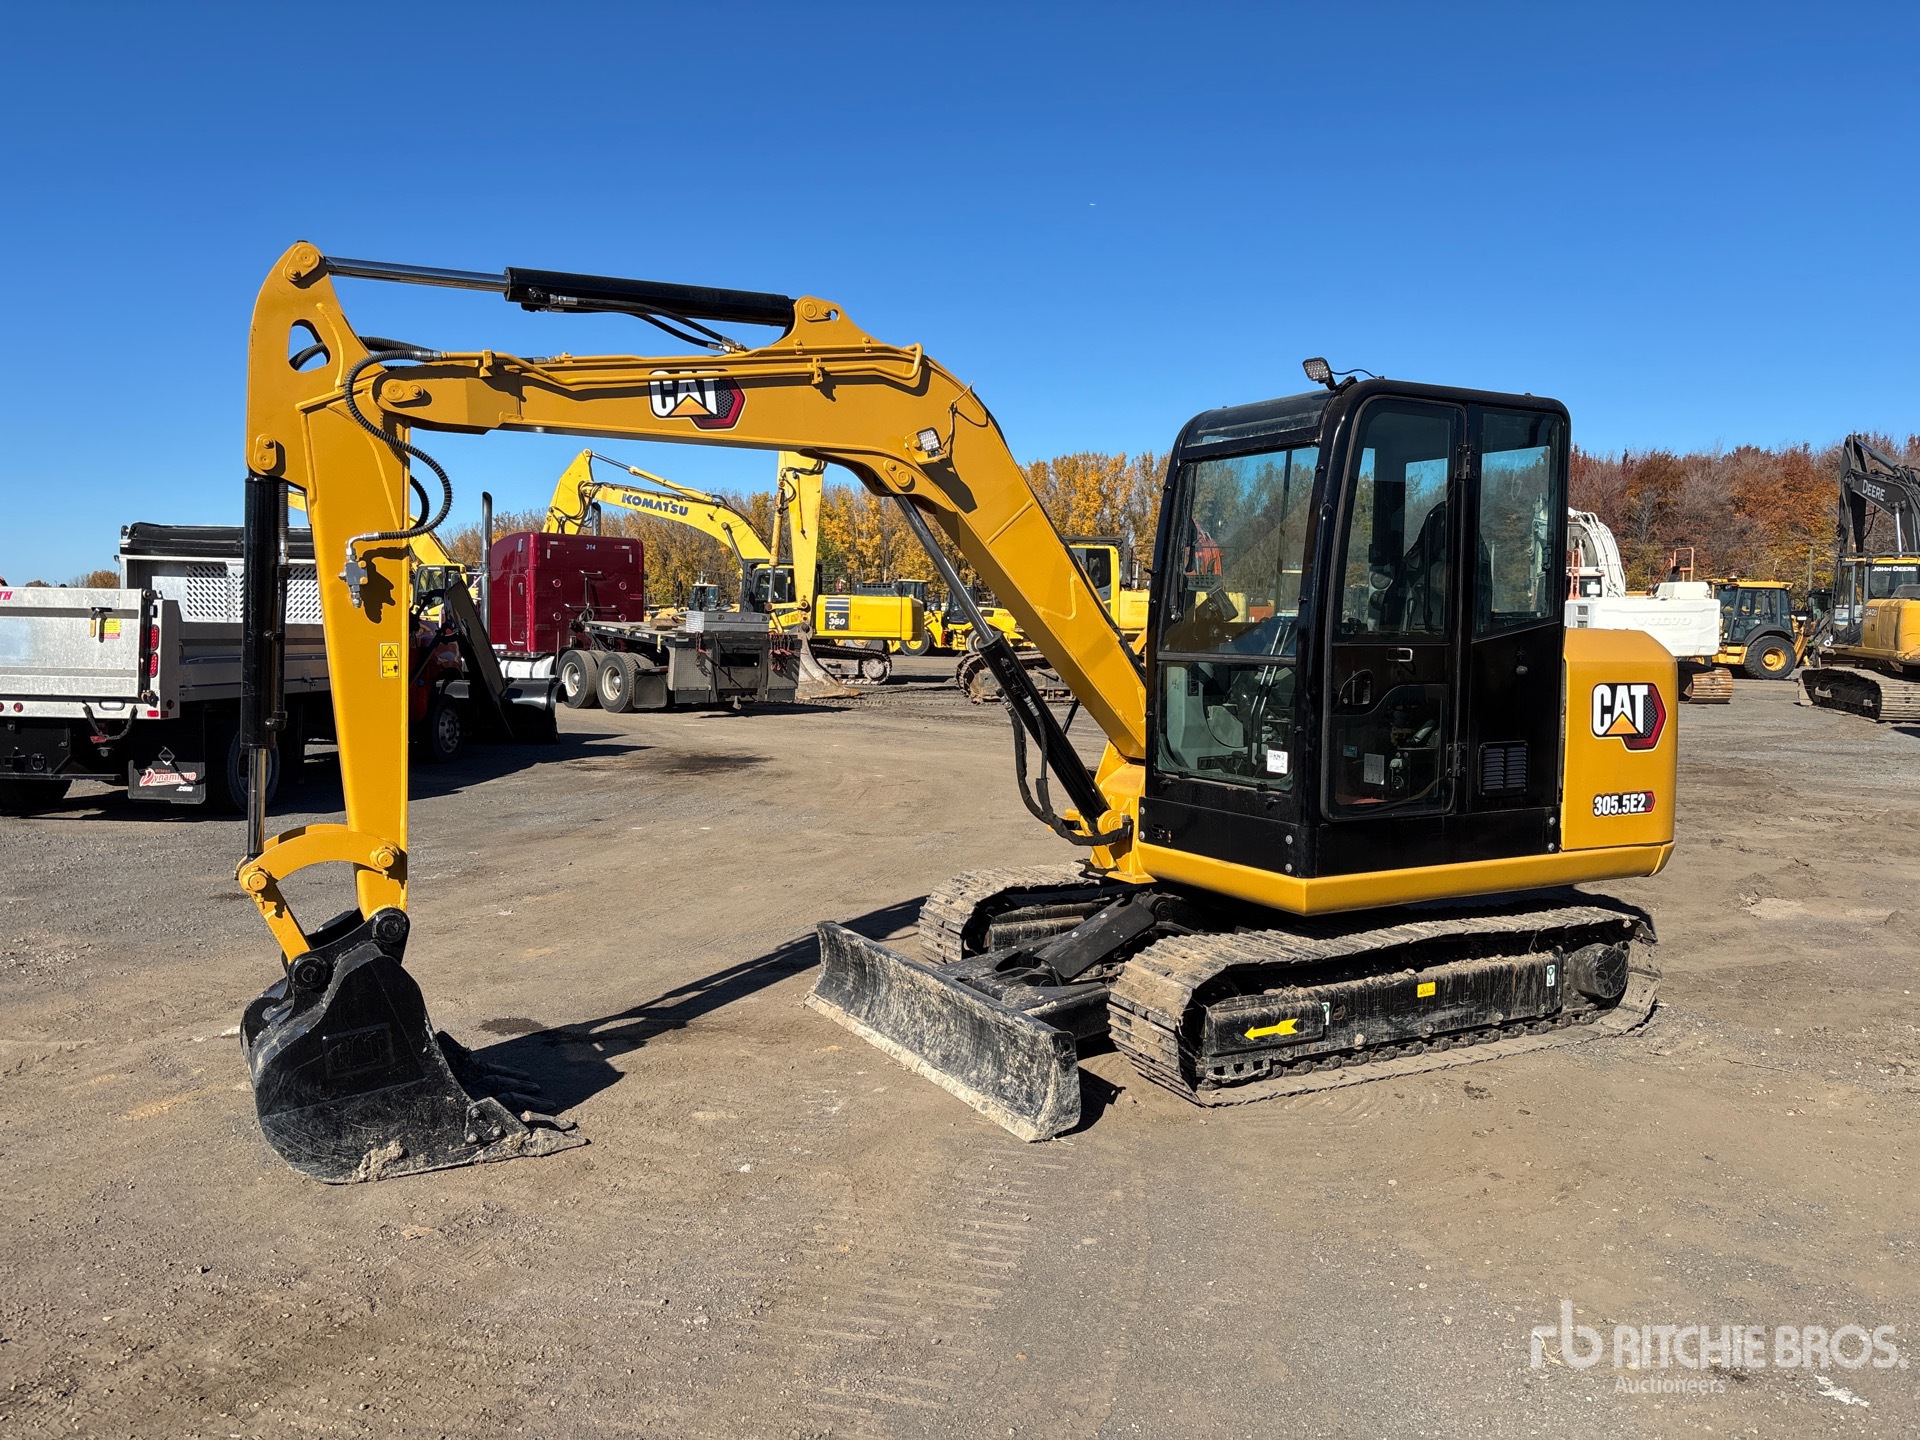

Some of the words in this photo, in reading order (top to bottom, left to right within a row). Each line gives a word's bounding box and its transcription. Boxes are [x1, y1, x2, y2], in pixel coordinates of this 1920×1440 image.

[650, 370, 719, 416] CAT
[1862, 479, 1886, 502] DEERE
[622, 494, 688, 516] KOMATSU
[828, 618, 846, 626] 360
[1633, 617, 1692, 626] VOLVO
[1593, 684, 1649, 736] CAT
[1593, 793, 1647, 816] 305.5E2
